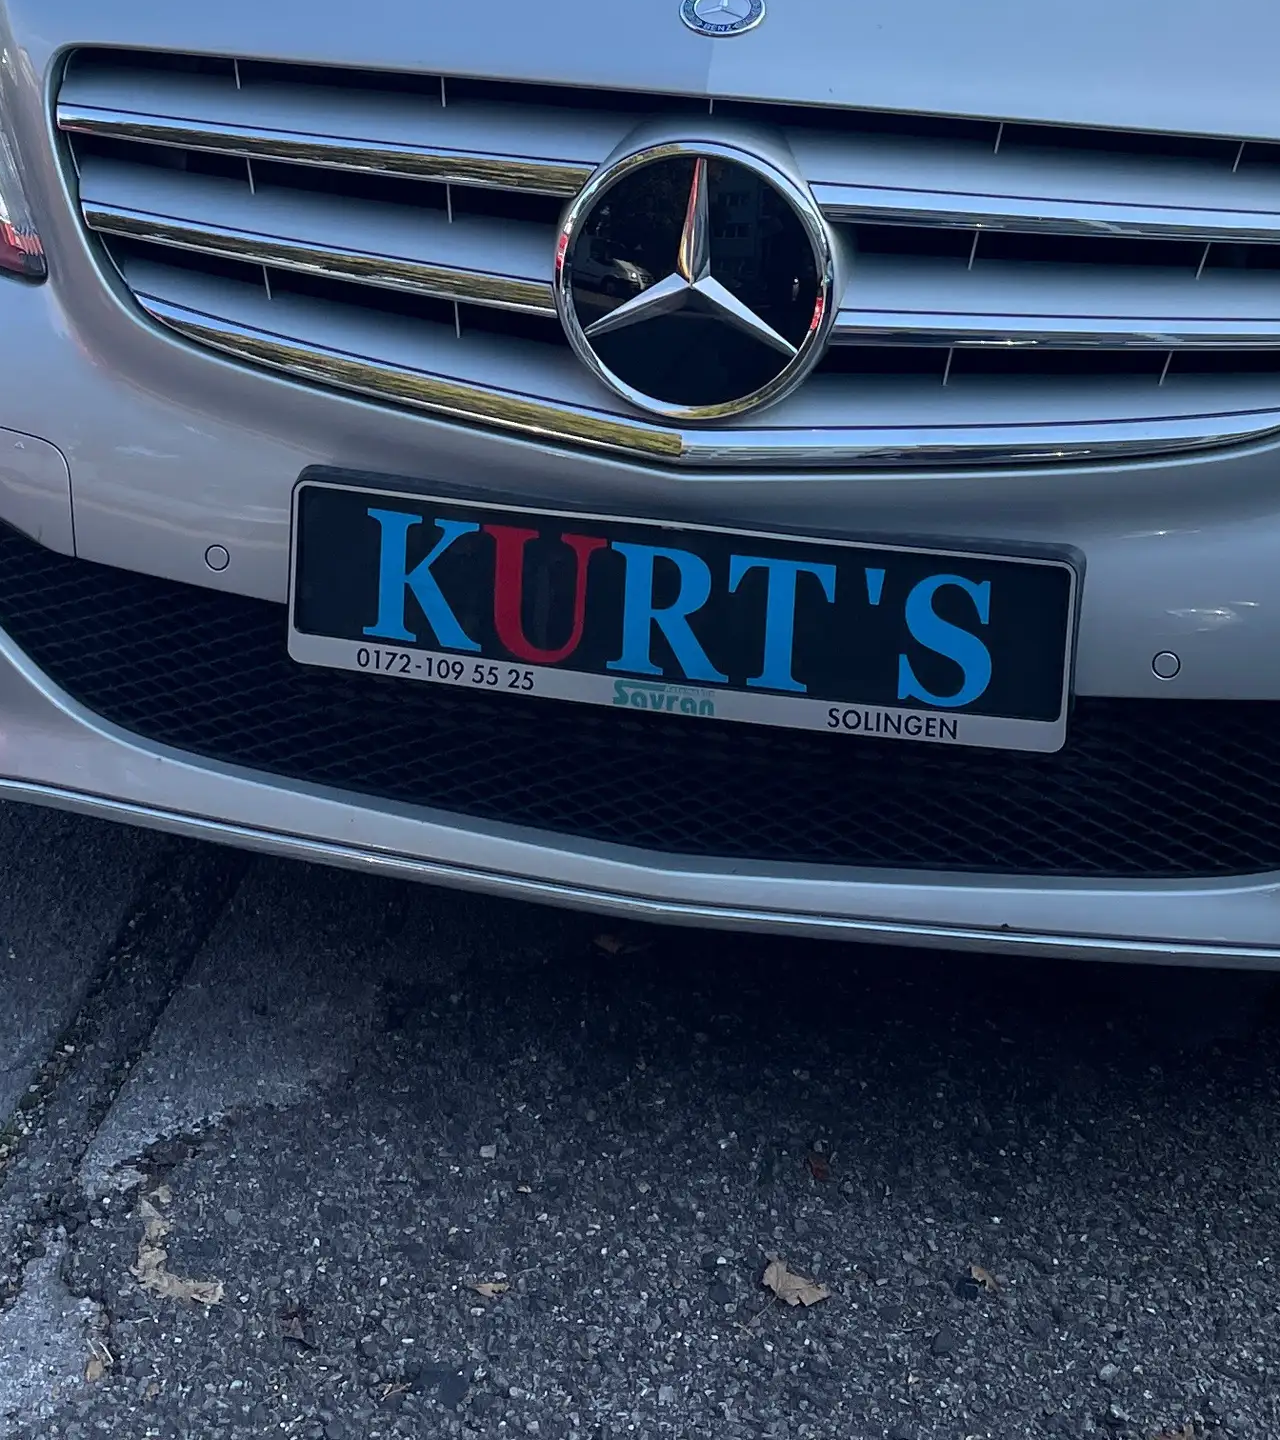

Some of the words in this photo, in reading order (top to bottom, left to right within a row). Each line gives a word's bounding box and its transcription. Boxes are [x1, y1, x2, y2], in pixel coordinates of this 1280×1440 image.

[362, 507, 993, 707] KURT'S
[356, 648, 465, 681] 0172-109
[471, 664, 499, 686] 55
[507, 669, 534, 691] 25
[612, 679, 715, 717] Savran
[827, 708, 958, 740] SOLINGEN
